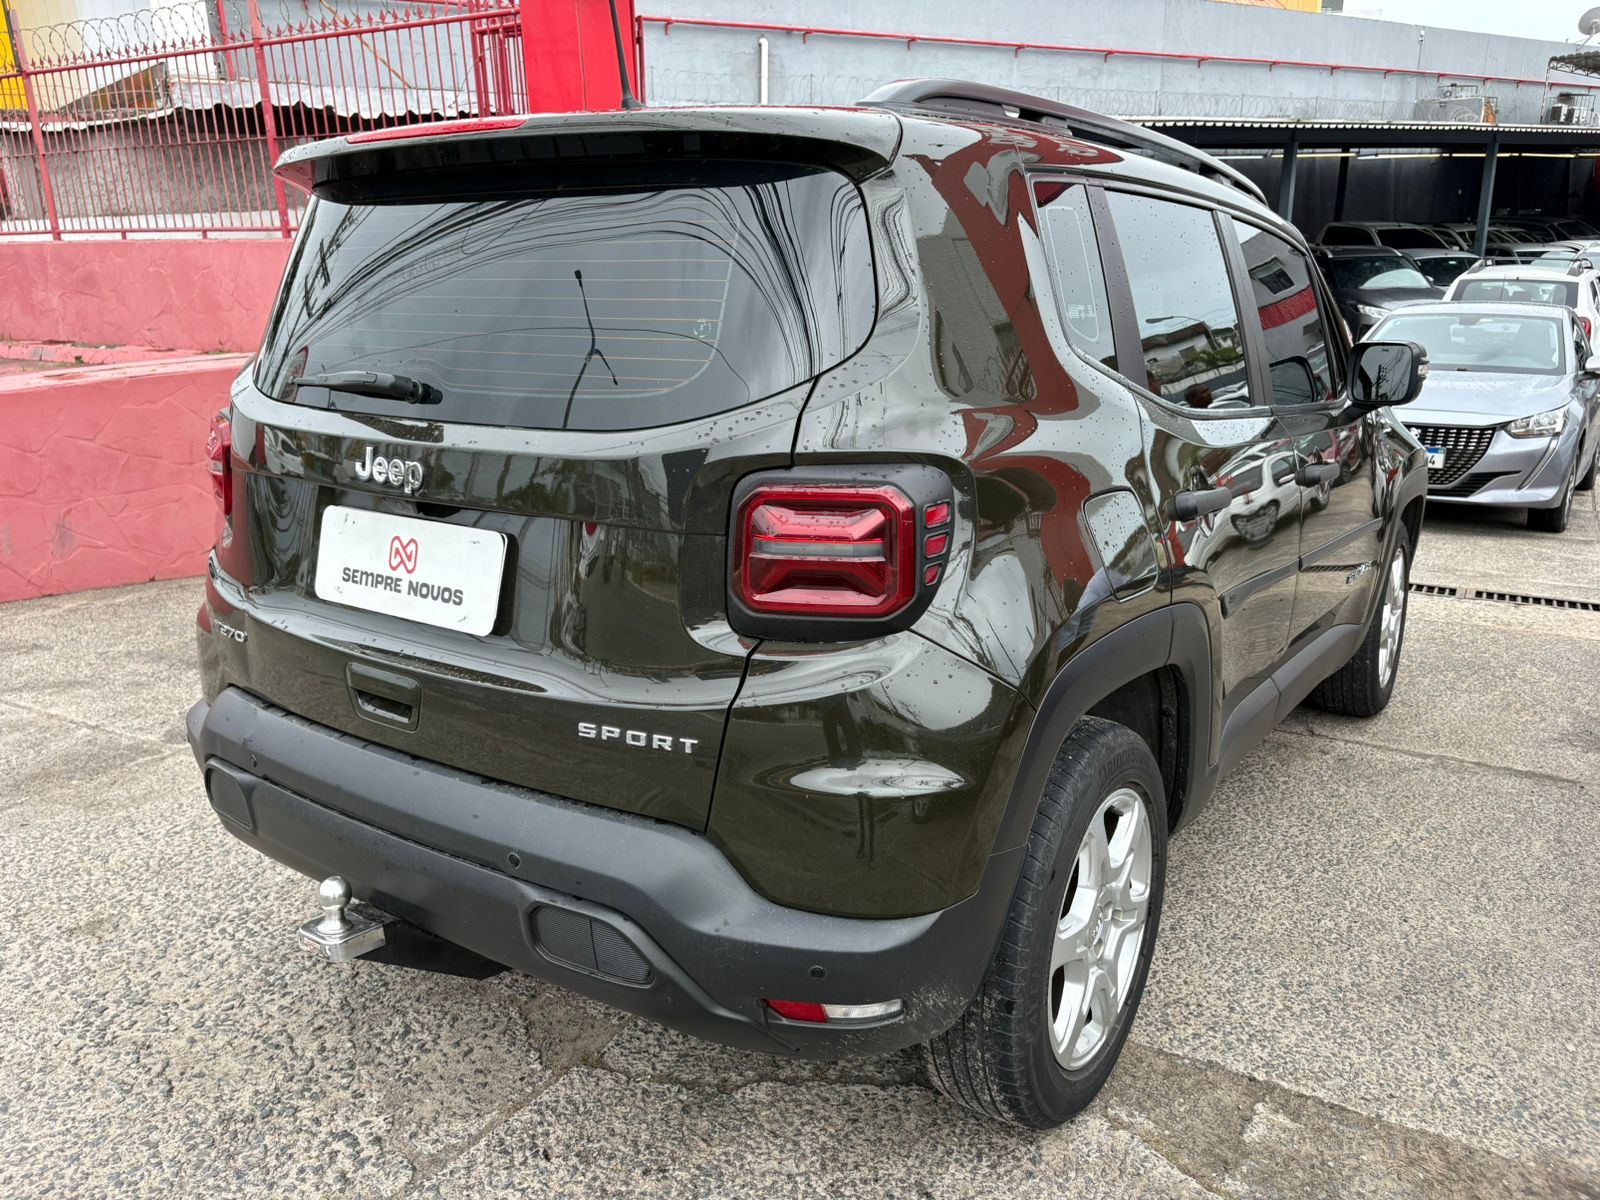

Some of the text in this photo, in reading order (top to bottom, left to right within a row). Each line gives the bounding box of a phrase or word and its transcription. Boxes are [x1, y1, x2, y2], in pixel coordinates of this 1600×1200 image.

[354, 446, 423, 494] Jeep
[342, 566, 464, 606] SEMPRE NOVOS
[578, 722, 699, 754] SPORT
